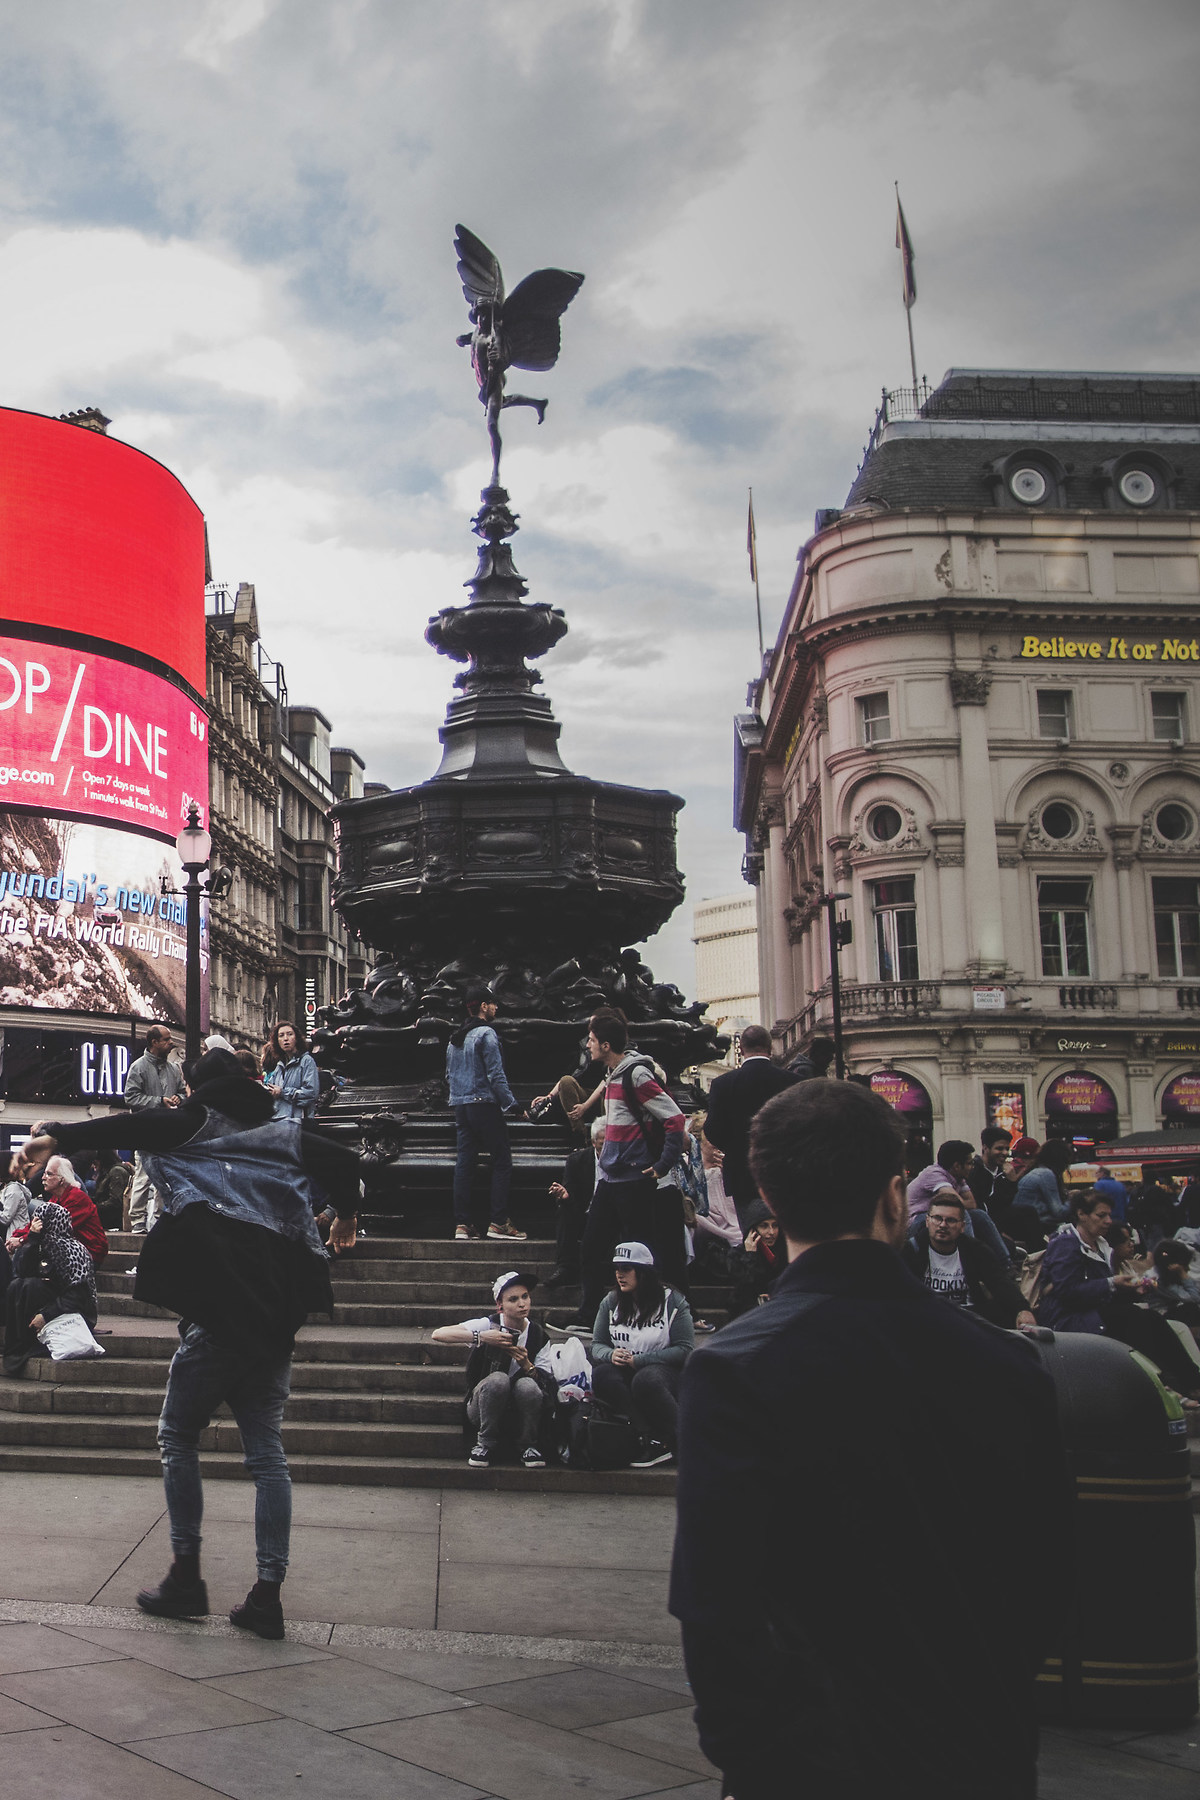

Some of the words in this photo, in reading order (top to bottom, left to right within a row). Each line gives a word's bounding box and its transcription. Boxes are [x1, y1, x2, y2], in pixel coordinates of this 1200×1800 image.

[1021, 636, 1102, 658] Believe
[1107, 637, 1128, 659] It
[1132, 643, 1157, 660] or
[83, 704, 168, 779] DINE
[82, 770, 105, 785] Open
[106, 775, 112, 785] 7
[113, 777, 128, 791] days
[135, 784, 150, 797] week
[90, 789, 119, 804] minute's
[120, 794, 135, 808] walk
[115, 887, 156, 915] new
[159, 893, 206, 937] challe
[34, 914, 68, 940] FIA
[74, 917, 125, 946] World
[128, 926, 160, 958] Rally
[81, 1041, 128, 1095] GAP
[871, 1084, 897, 1093] elieve
[1056, 1084, 1091, 1094] Believe
